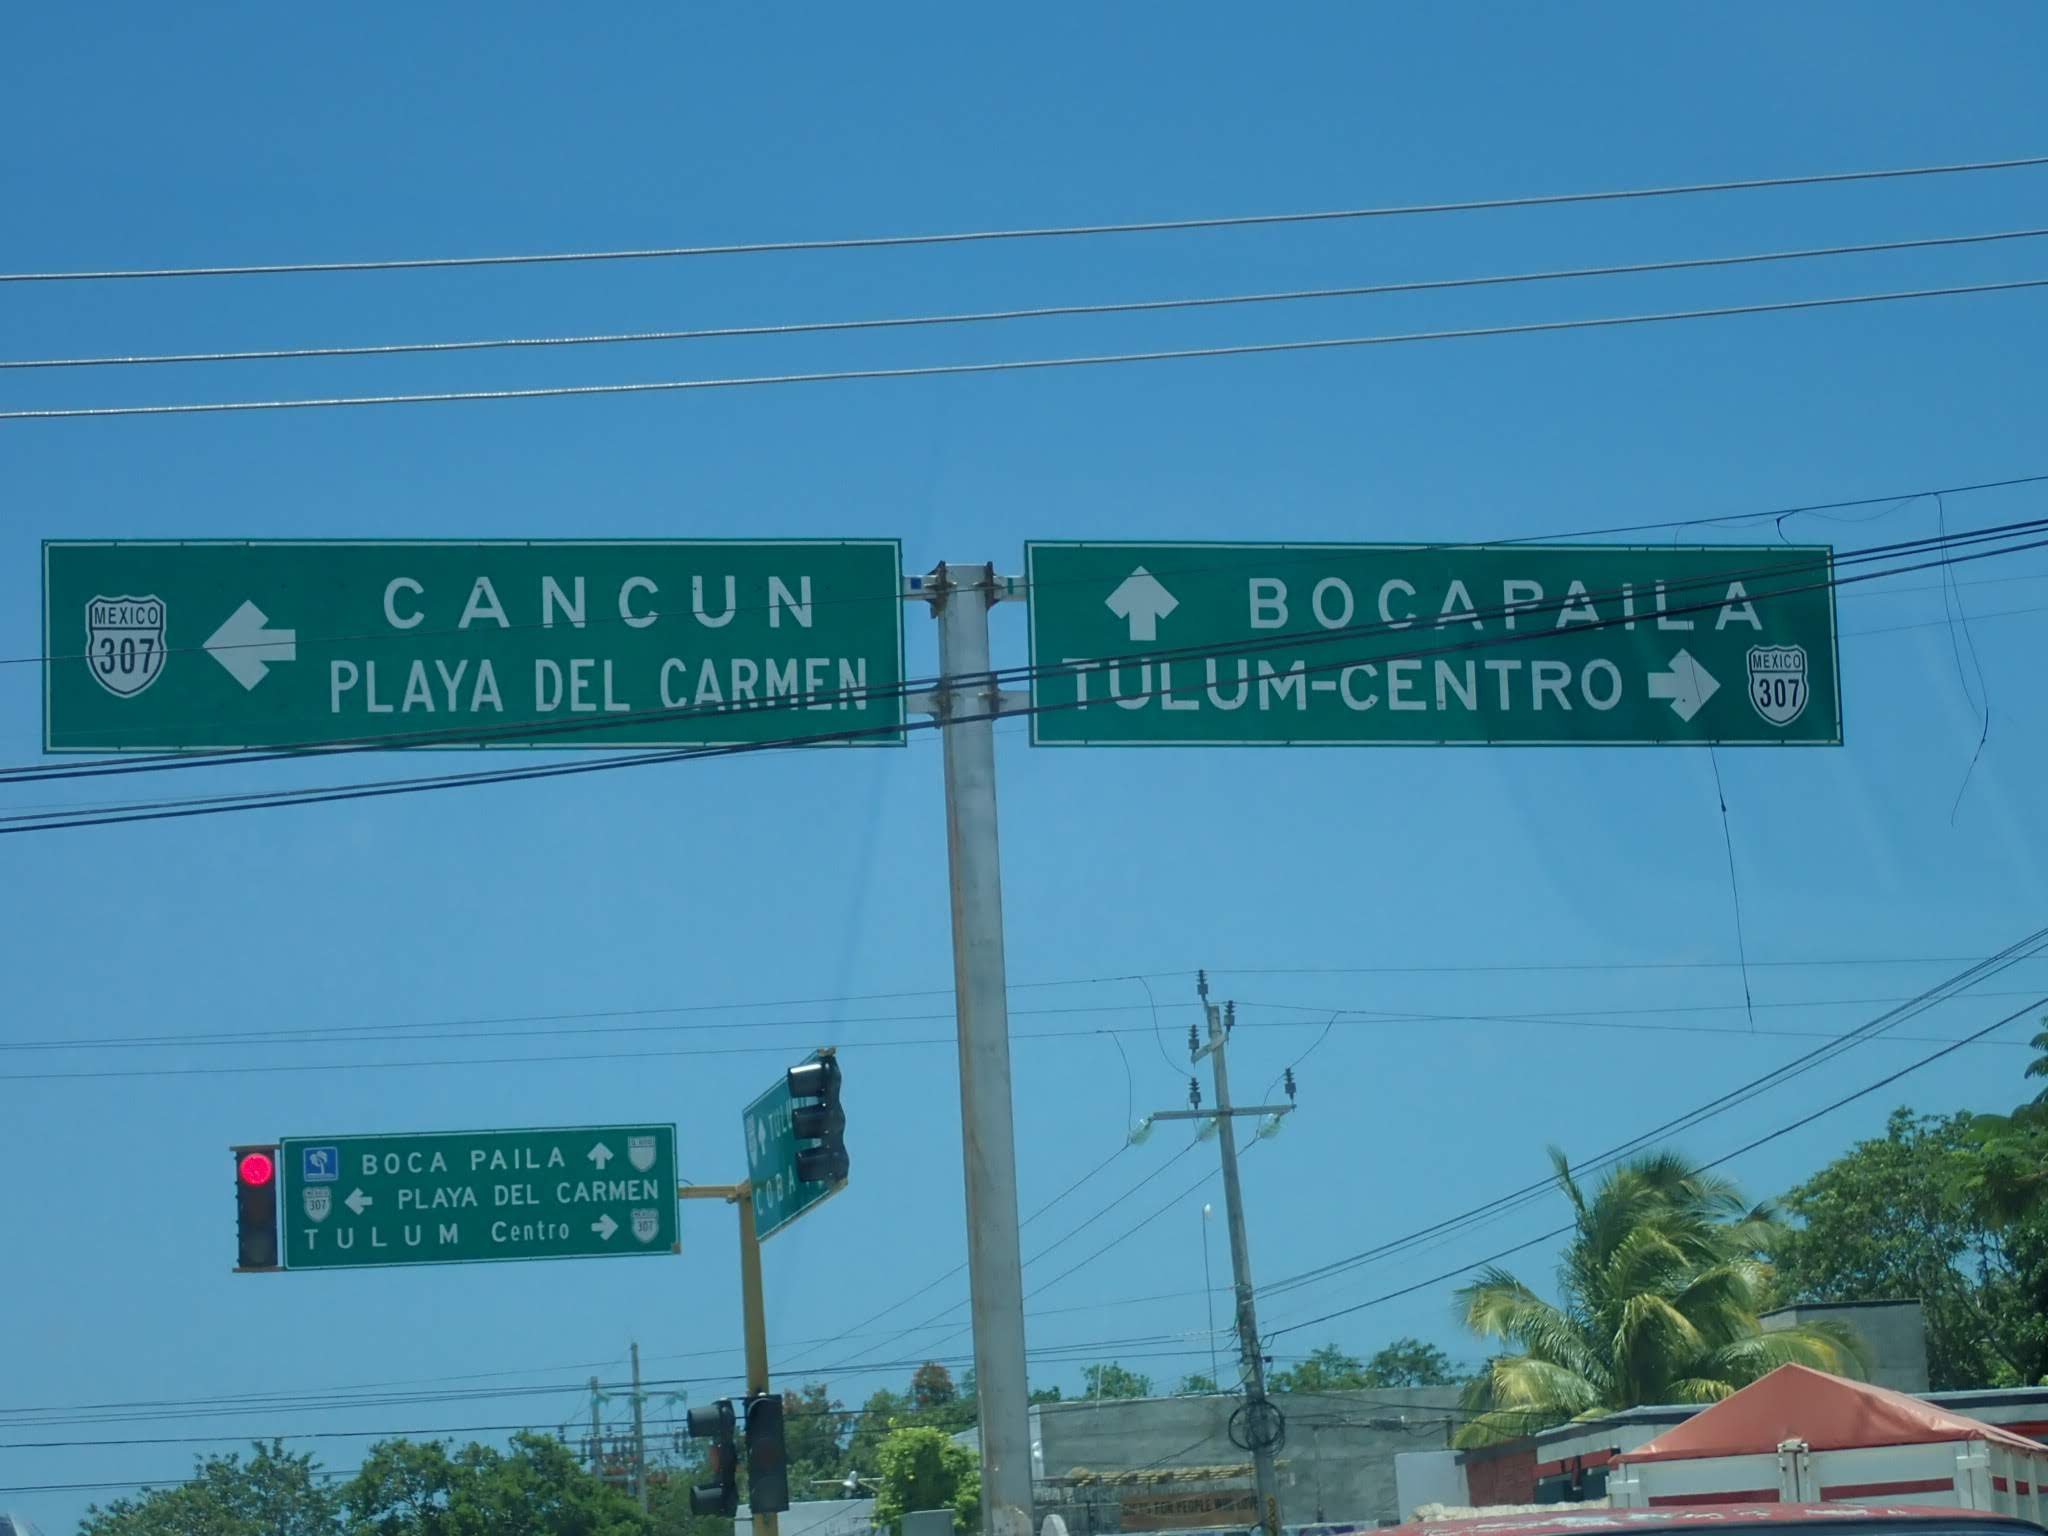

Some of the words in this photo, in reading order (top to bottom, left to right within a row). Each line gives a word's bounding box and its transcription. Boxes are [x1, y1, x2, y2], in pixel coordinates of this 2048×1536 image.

[94, 606, 159, 625] MEXICO
[384, 576, 812, 629] CANCUN
[1249, 577, 1763, 631] BOCAPAILA
[100, 637, 155, 674] 307
[1753, 654, 1801, 669] MEXICO
[330, 659, 504, 713] PLAYA
[535, 658, 631, 713] DEL
[660, 657, 867, 711] CARMEN
[1061, 657, 1623, 711] TULUM-CENTRO
[1759, 678, 1800, 708] 307
[362, 1151, 448, 1176] BOCA
[470, 1146, 565, 1171] PAILA
[310, 1199, 327, 1211] 307
[398, 1186, 478, 1210] PLAYA
[494, 1183, 540, 1206] DEL
[556, 1179, 659, 1204] CARMEN
[756, 1165, 795, 1216] COBA
[304, 1223, 458, 1250] TULUM
[491, 1219, 570, 1243] Centro
